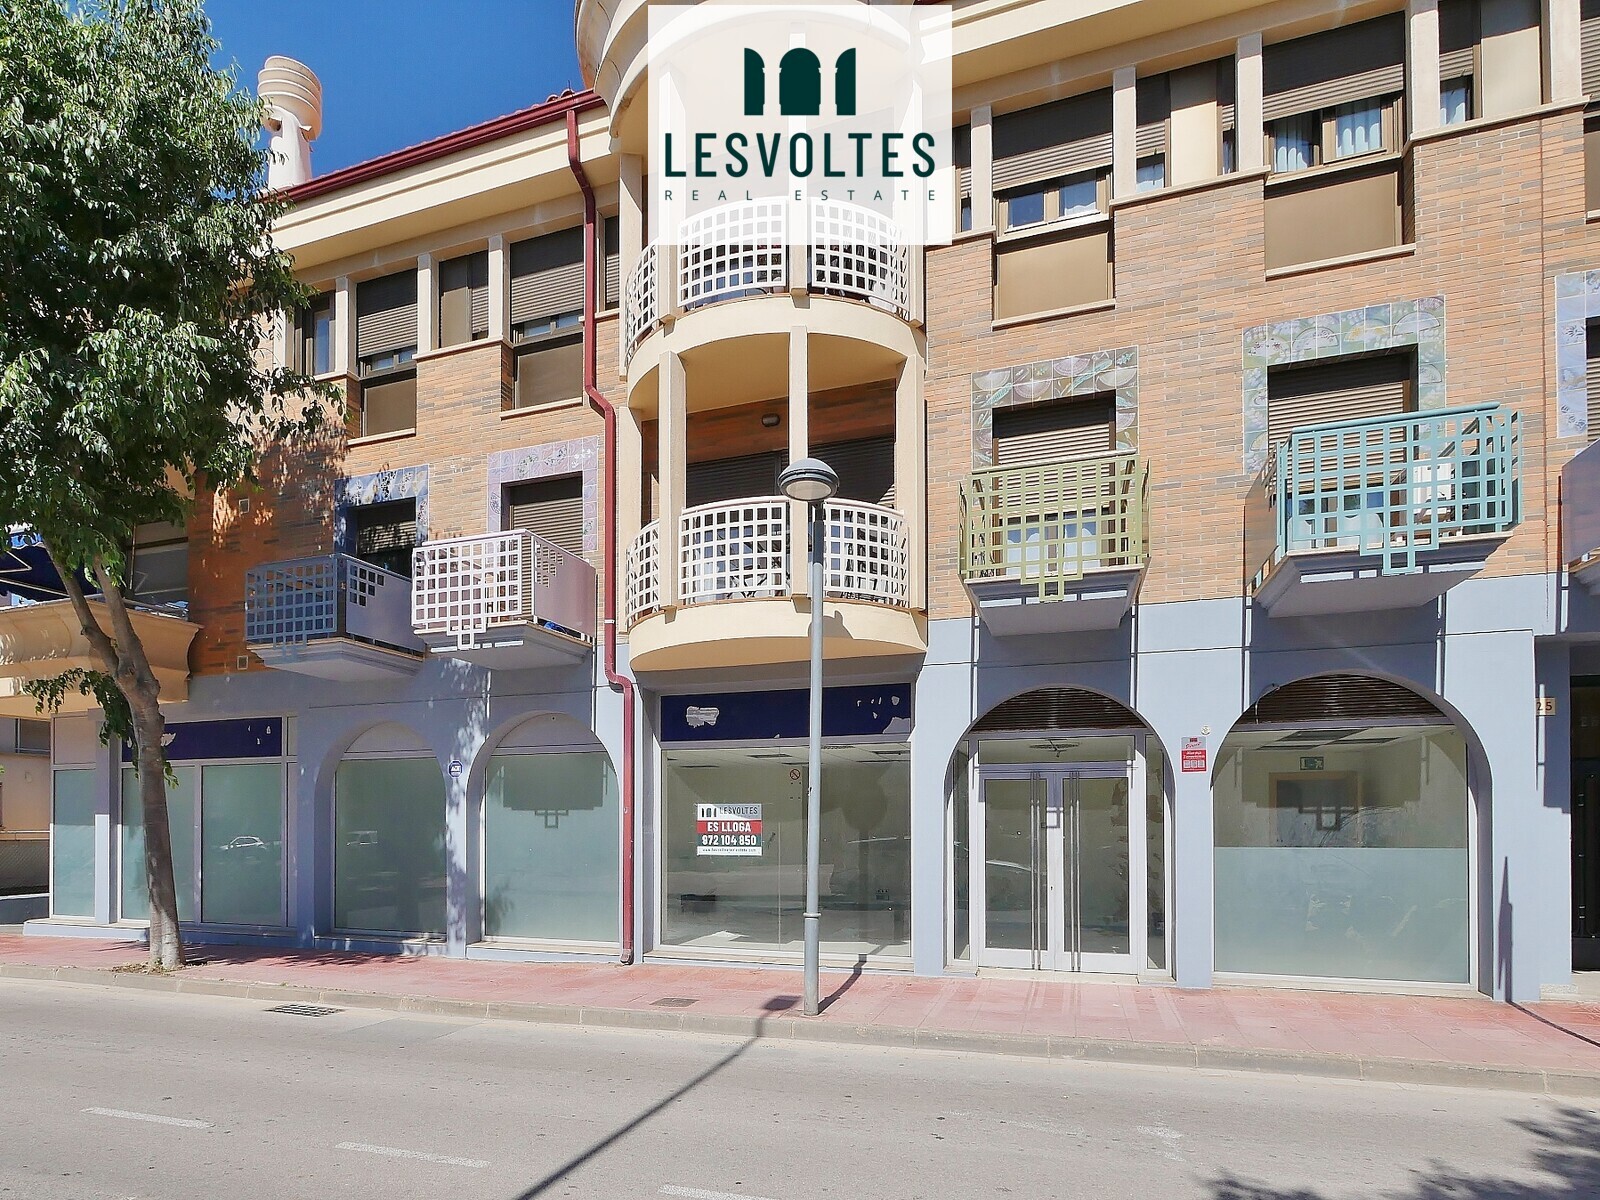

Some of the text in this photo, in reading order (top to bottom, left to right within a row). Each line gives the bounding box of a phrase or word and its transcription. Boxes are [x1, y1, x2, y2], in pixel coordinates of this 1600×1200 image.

[1536, 701, 1553, 711] 25
[719, 806, 758, 815] LESVOLTES
[707, 822, 751, 832] ES LLOGA
[721, 834, 737, 846] 104
[739, 834, 757, 846] 850
